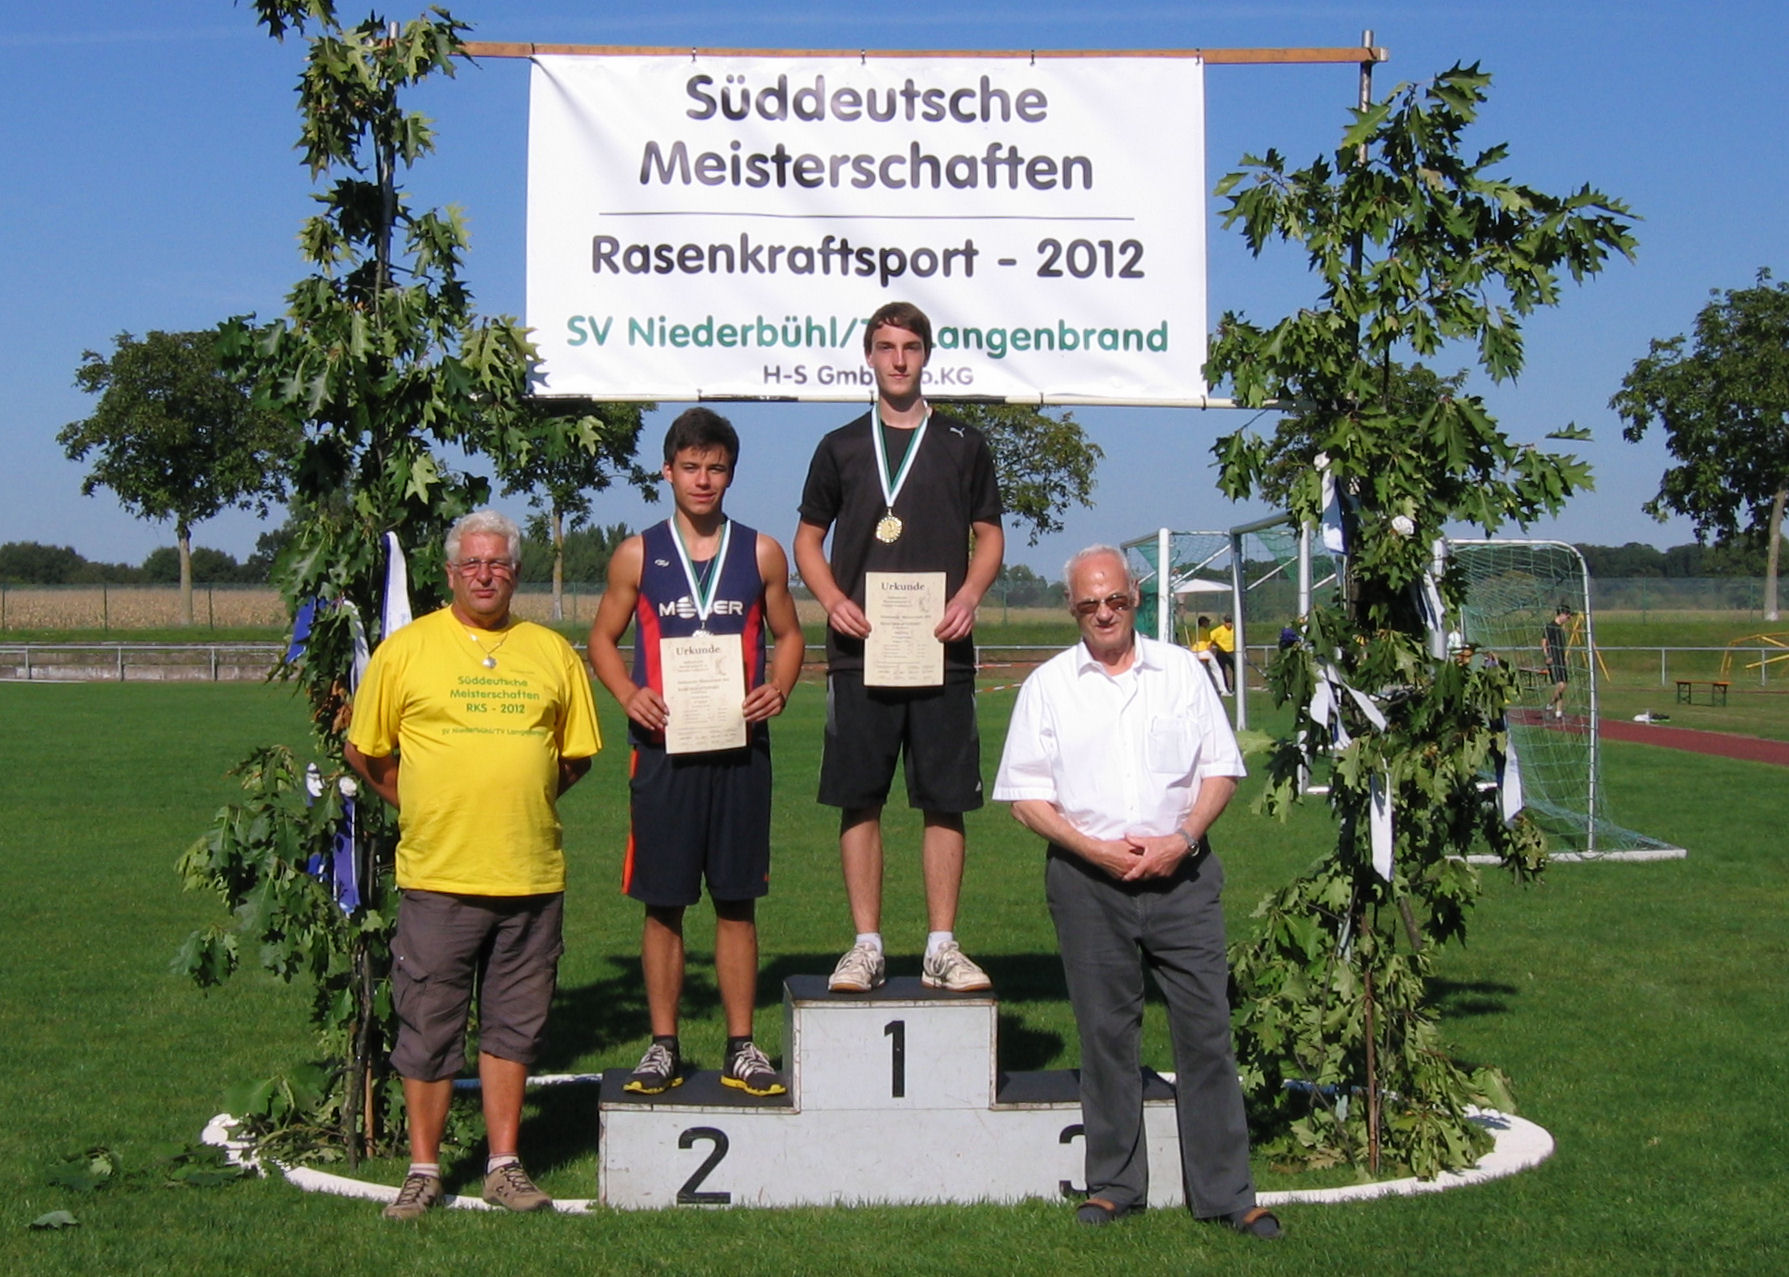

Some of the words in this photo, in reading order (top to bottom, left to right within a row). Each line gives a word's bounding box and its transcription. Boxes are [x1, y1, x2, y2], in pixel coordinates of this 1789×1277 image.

[686, 74, 1049, 124] Süddeutsche
[639, 140, 1093, 191] Meisterschaften
[592, 232, 980, 288] Rasenkraftsport
[997, 258, 1017, 267] -
[1036, 237, 1145, 279] 2012
[566, 315, 612, 347] SV
[628, 315, 872, 348] Niederbühl/
[931, 319, 1169, 360] angenbrand
[763, 365, 808, 385] H-S
[817, 365, 874, 386] Gmb
[921, 366, 974, 386] o.KG
[881, 581, 926, 592] Urkunde
[658, 594, 744, 619] MOER
[675, 646, 721, 656] Urkunde
[457, 675, 528, 687] Süddeutsche
[450, 689, 540, 700] Meisterschaften
[466, 703, 487, 713] RKS
[500, 703, 525, 714] 2012
[884, 1020, 905, 1098] 1
[676, 1126, 731, 1206] 2
